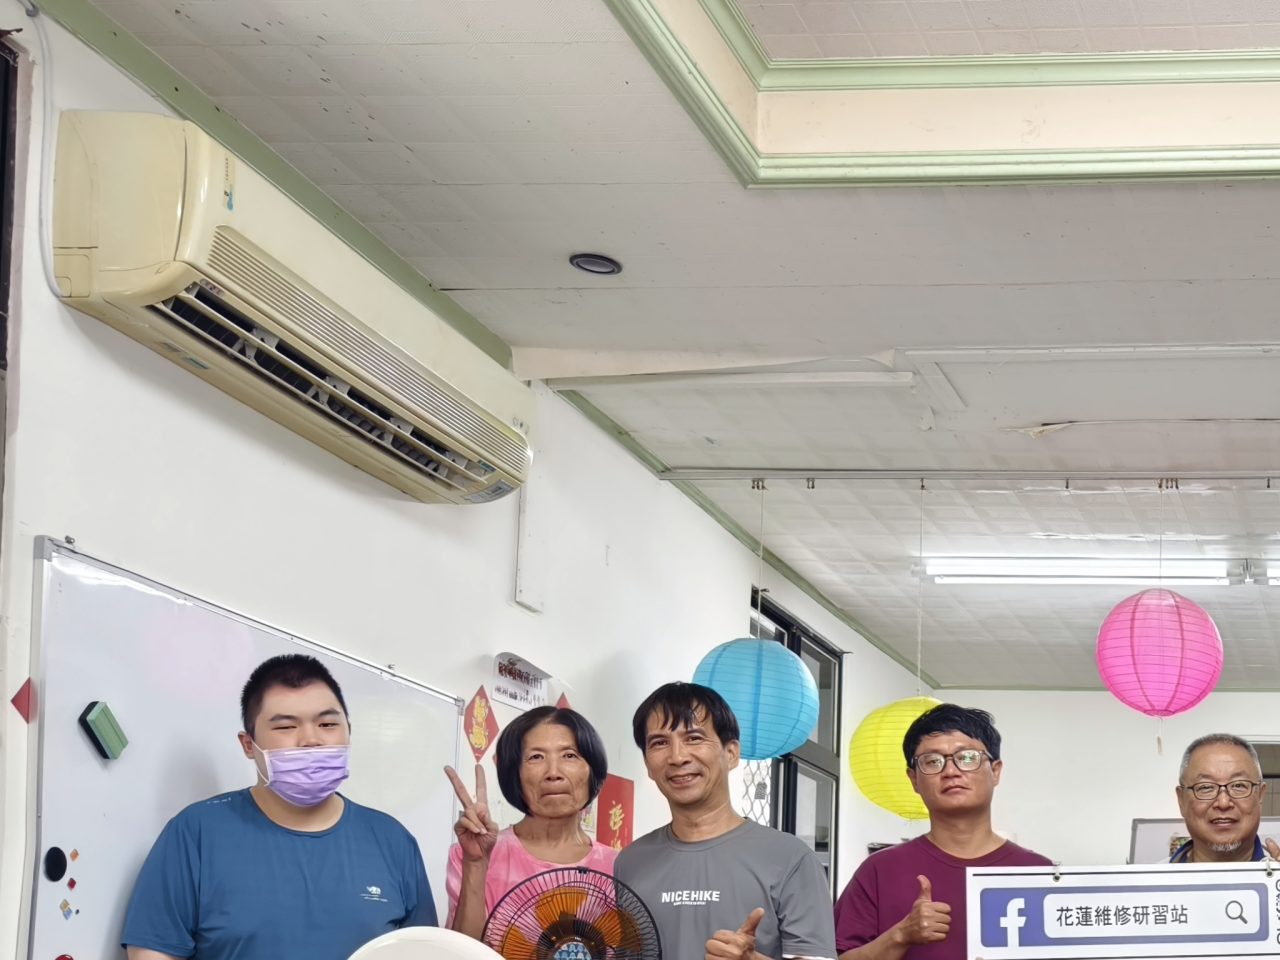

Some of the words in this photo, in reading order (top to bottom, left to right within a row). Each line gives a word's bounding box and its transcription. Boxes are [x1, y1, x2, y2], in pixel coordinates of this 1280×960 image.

[661, 890, 721, 903] NICEHIKE
[1055, 904, 1188, 927] 花蓮維修研習站
